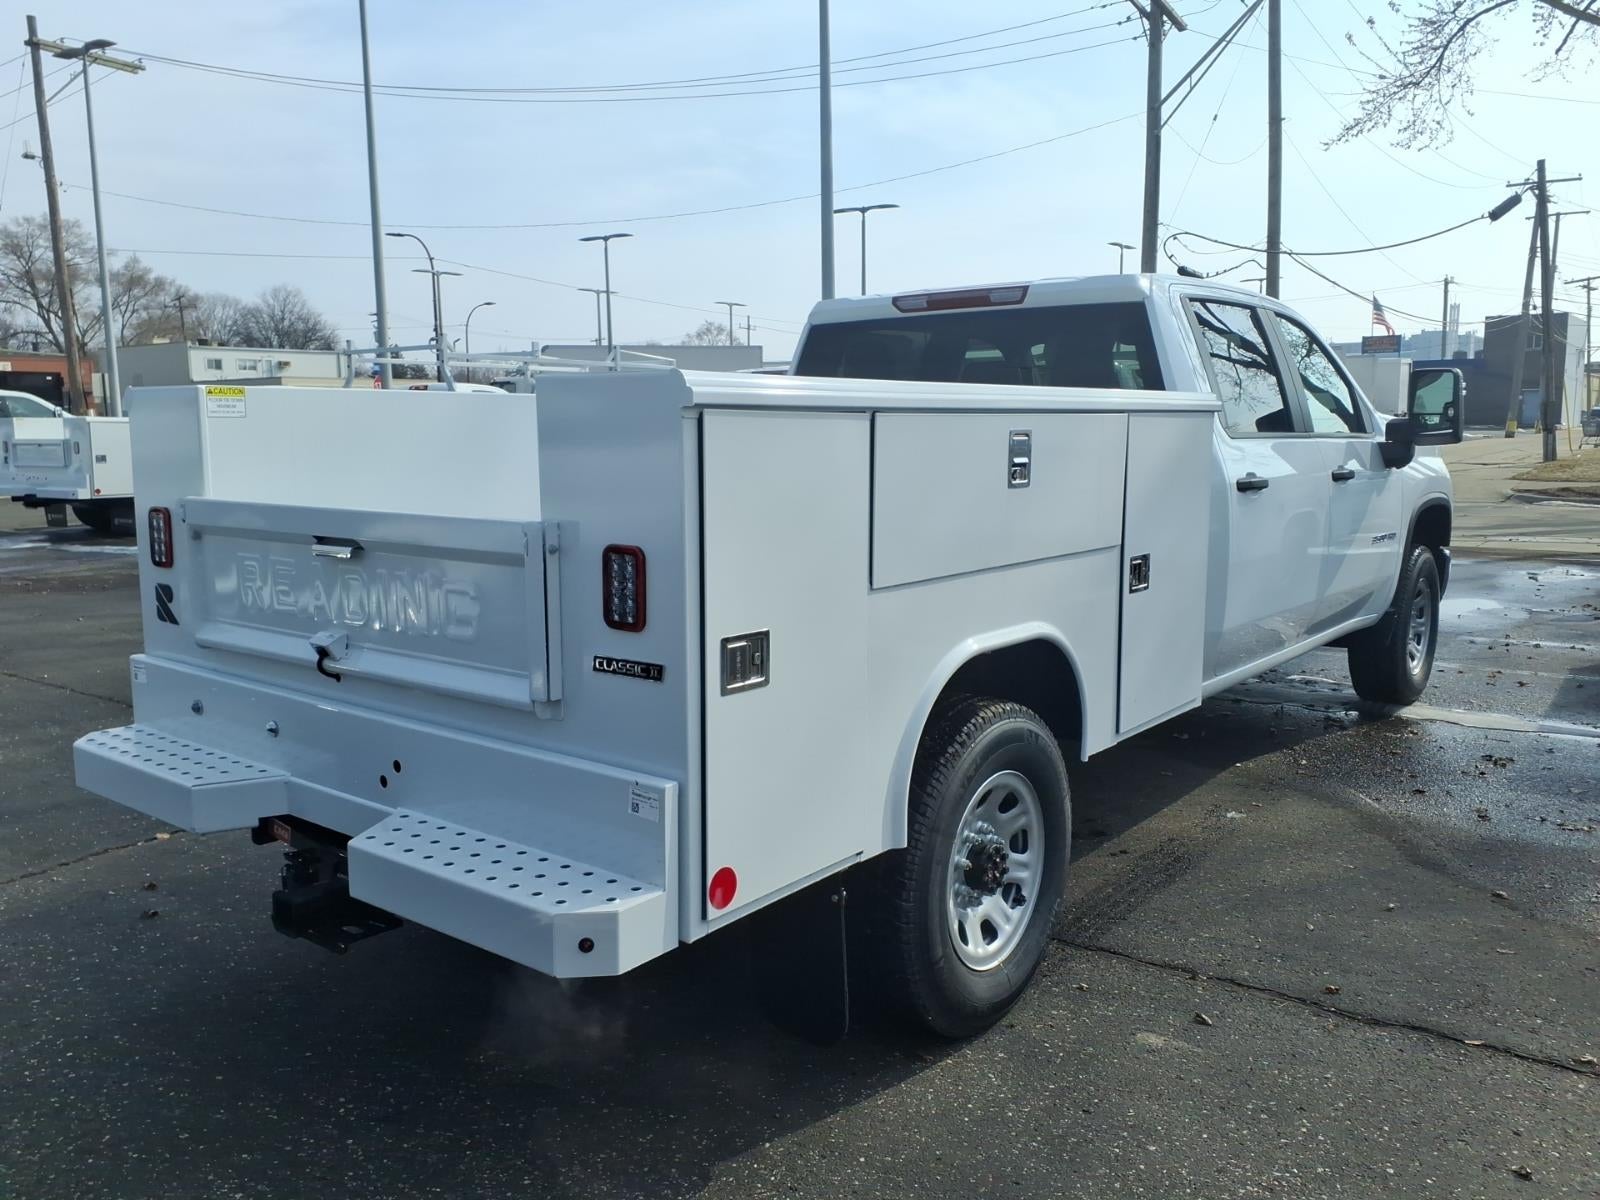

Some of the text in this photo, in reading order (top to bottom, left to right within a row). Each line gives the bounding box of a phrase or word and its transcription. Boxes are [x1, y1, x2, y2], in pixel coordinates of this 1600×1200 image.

[213, 387, 244, 395] CAUTION
[237, 553, 480, 639] READING
[595, 658, 647, 676] CLASSIC
